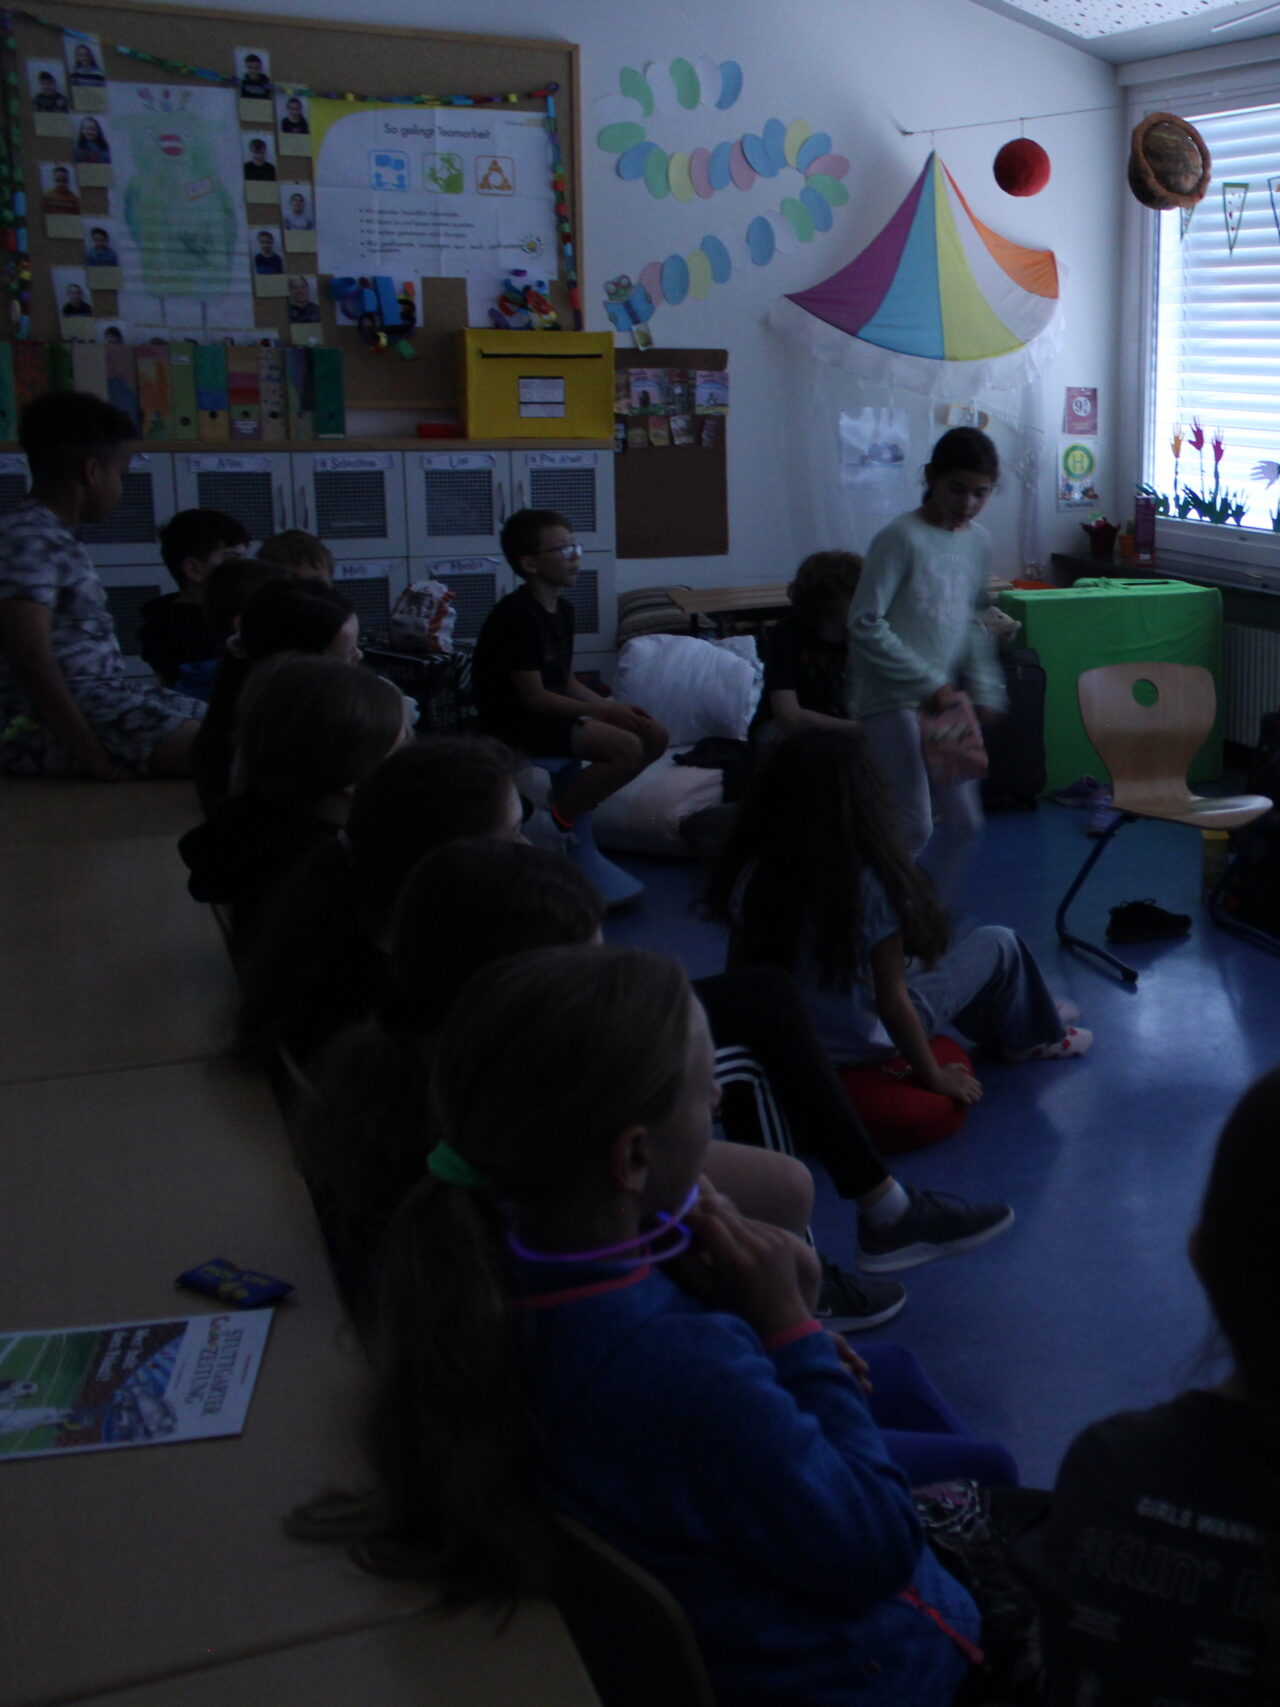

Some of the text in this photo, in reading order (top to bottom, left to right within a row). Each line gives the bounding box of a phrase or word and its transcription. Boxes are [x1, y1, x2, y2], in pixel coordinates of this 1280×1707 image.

[384, 123, 490, 139] So gelingt Teamarbeit
[1072, 453, 1084, 472] H
[186, 1345, 219, 1404] ZEITUNG
[1136, 1494, 1193, 1529] GIRLS
